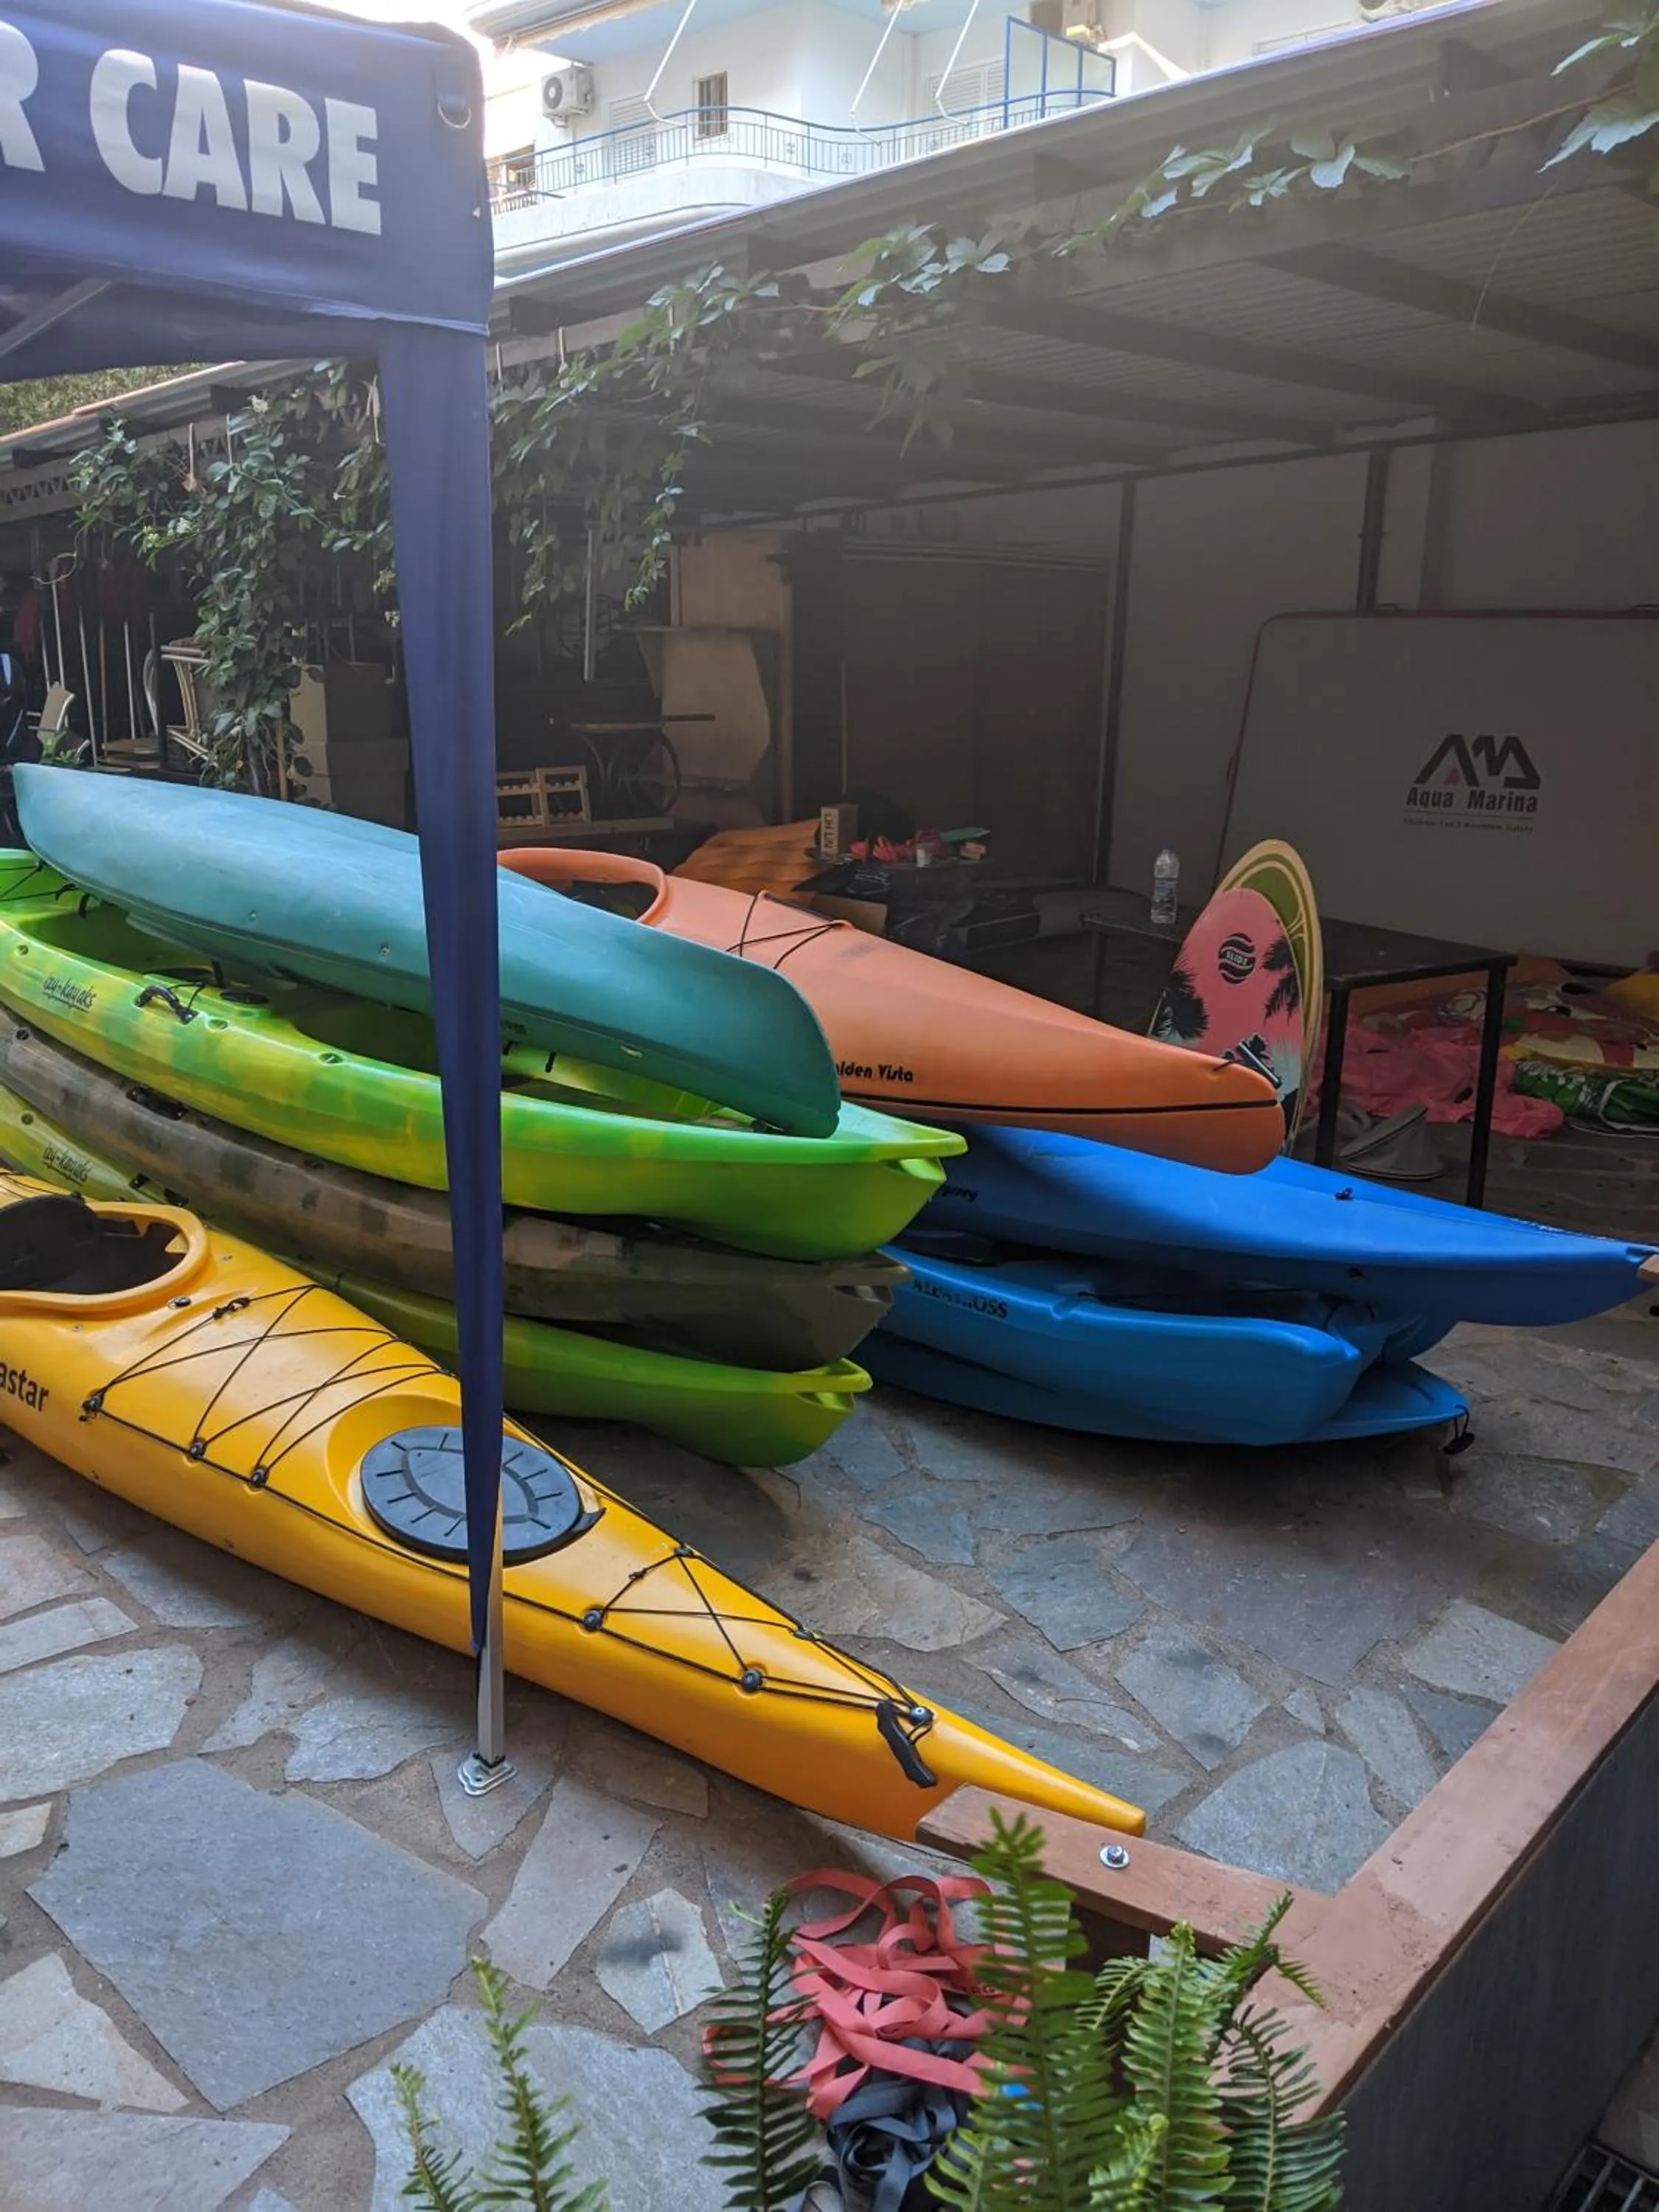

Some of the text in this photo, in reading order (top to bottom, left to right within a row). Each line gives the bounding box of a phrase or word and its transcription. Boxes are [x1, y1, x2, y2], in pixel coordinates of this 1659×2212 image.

[89, 48, 381, 236] CARE
[1405, 786, 1538, 813] Aqua Marina
[877, 1064, 914, 1082] Vista
